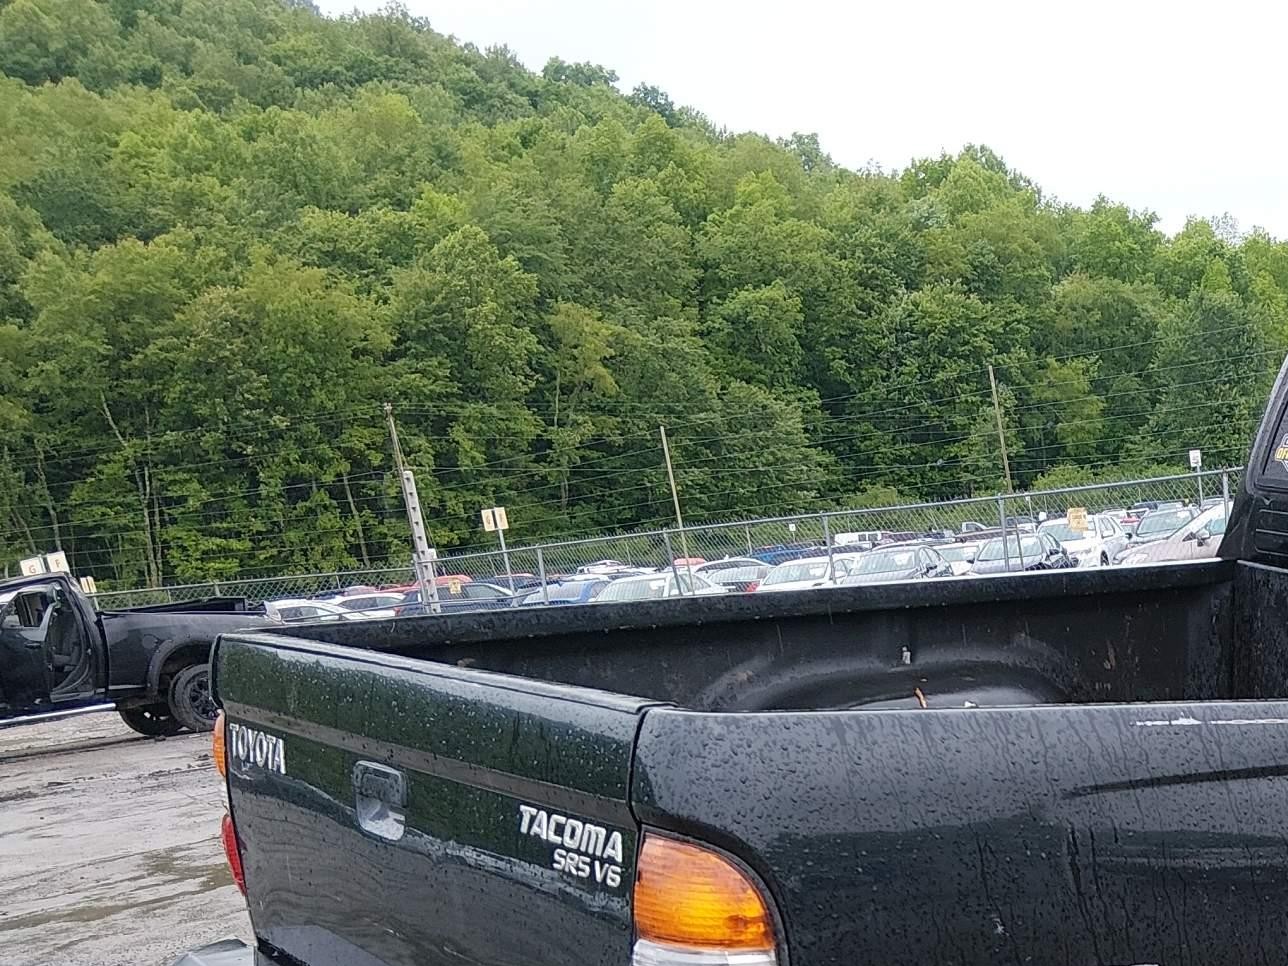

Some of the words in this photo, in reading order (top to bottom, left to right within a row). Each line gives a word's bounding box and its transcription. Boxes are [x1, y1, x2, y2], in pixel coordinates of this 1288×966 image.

[229, 722, 286, 774] TOYOTA
[519, 804, 622, 863] TACOMA
[552, 848, 591, 878] SR5
[593, 860, 621, 888] V6
